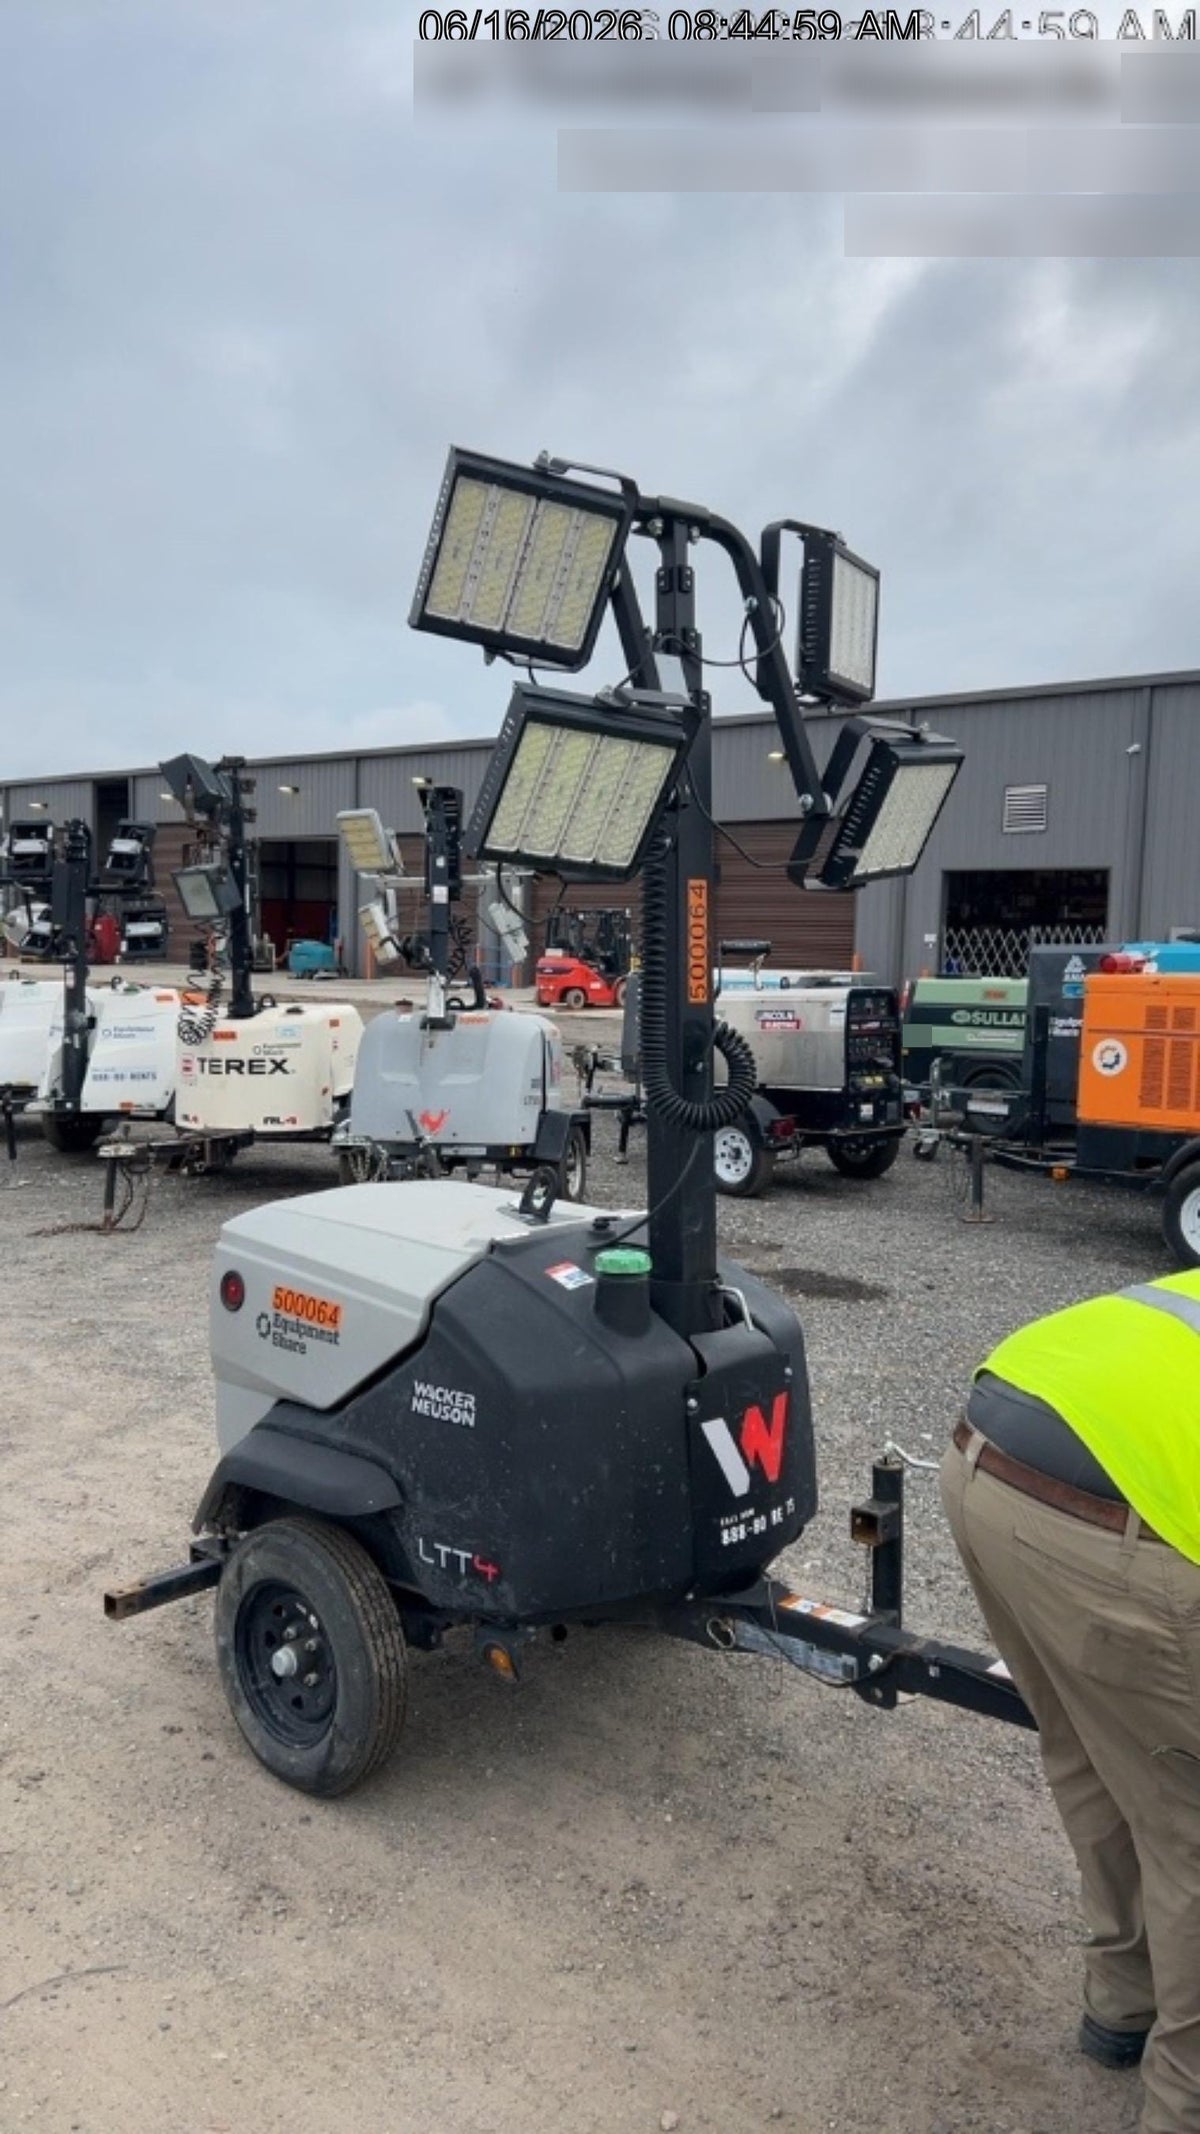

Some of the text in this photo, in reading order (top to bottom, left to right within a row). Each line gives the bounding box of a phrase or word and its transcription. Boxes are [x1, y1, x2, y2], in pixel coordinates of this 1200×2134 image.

[690, 884, 706, 999] 500064
[972, 1012, 1026, 1026] SULLA
[197, 1057, 290, 1075] TEREX
[273, 1287, 341, 1327] 500064
[272, 1313, 340, 1345] Equipment
[414, 1380, 476, 1410] WACKER
[412, 1396, 476, 1428] NEUSON
[419, 1538, 498, 1582] LTT4
